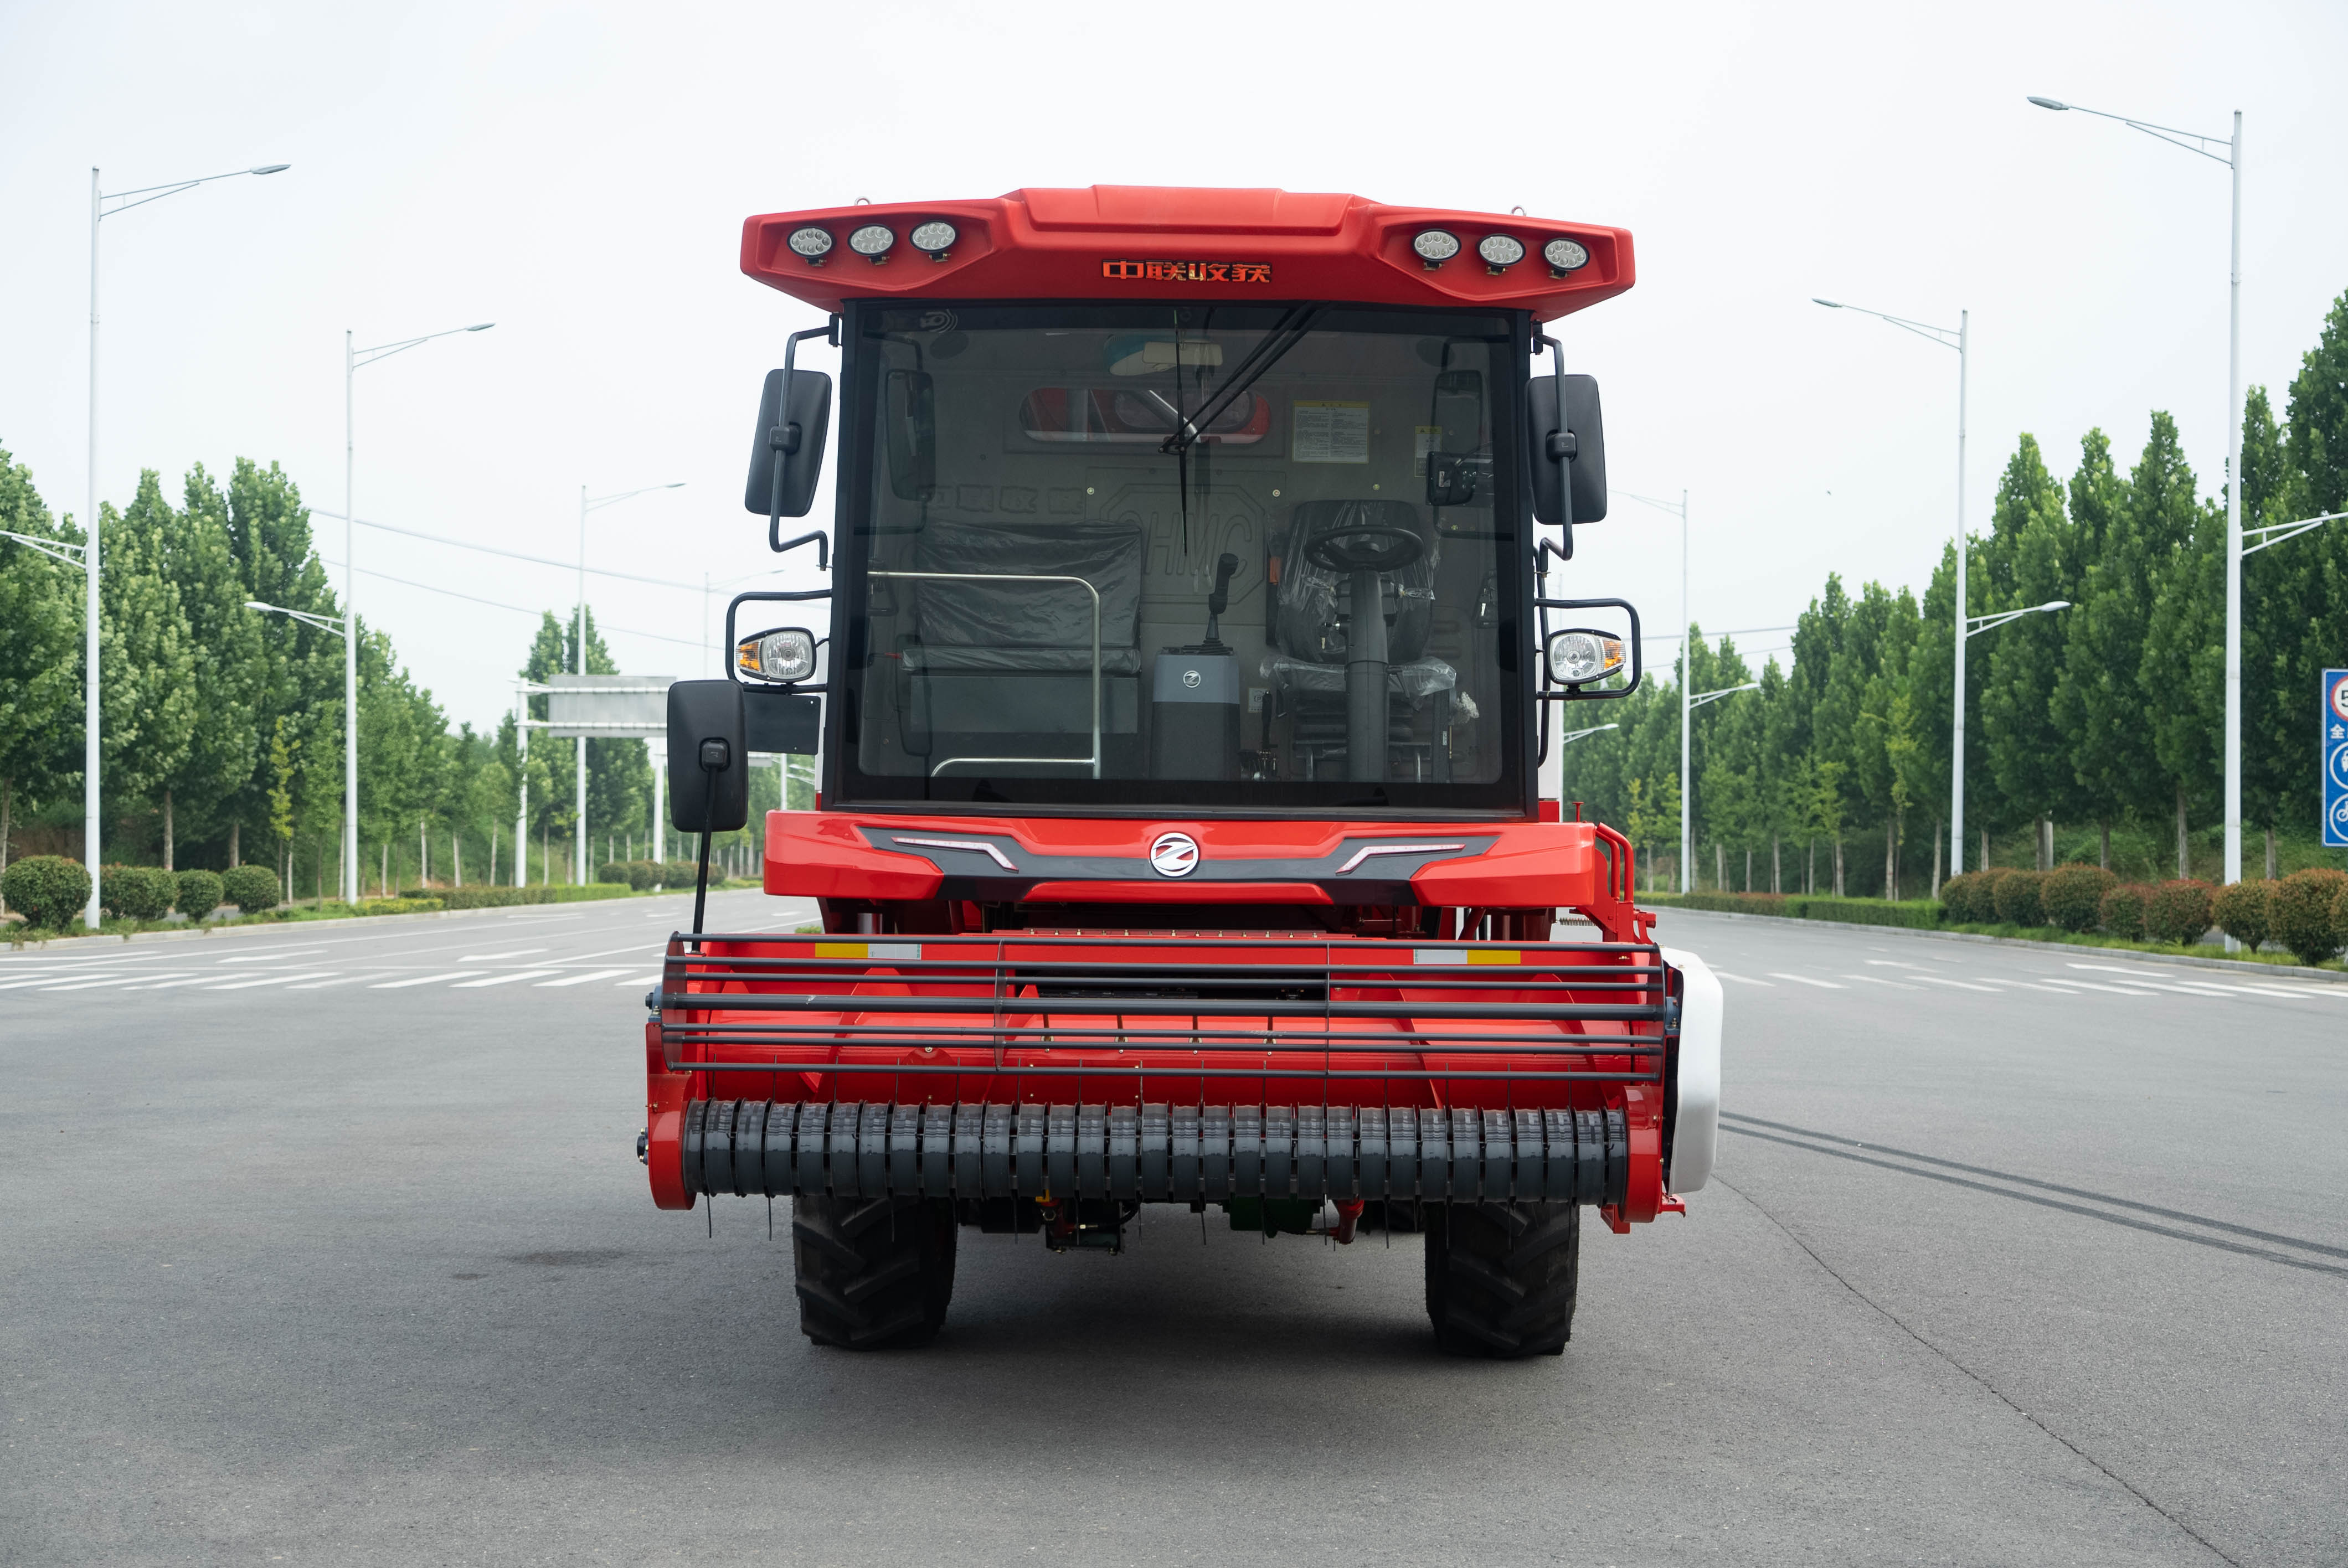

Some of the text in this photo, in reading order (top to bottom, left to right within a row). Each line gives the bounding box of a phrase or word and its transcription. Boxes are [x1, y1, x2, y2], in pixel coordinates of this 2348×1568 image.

[1102, 260, 1271, 283] 中联收获
[1117, 510, 1252, 579] HMC
[2330, 724, 2348, 739] 全
